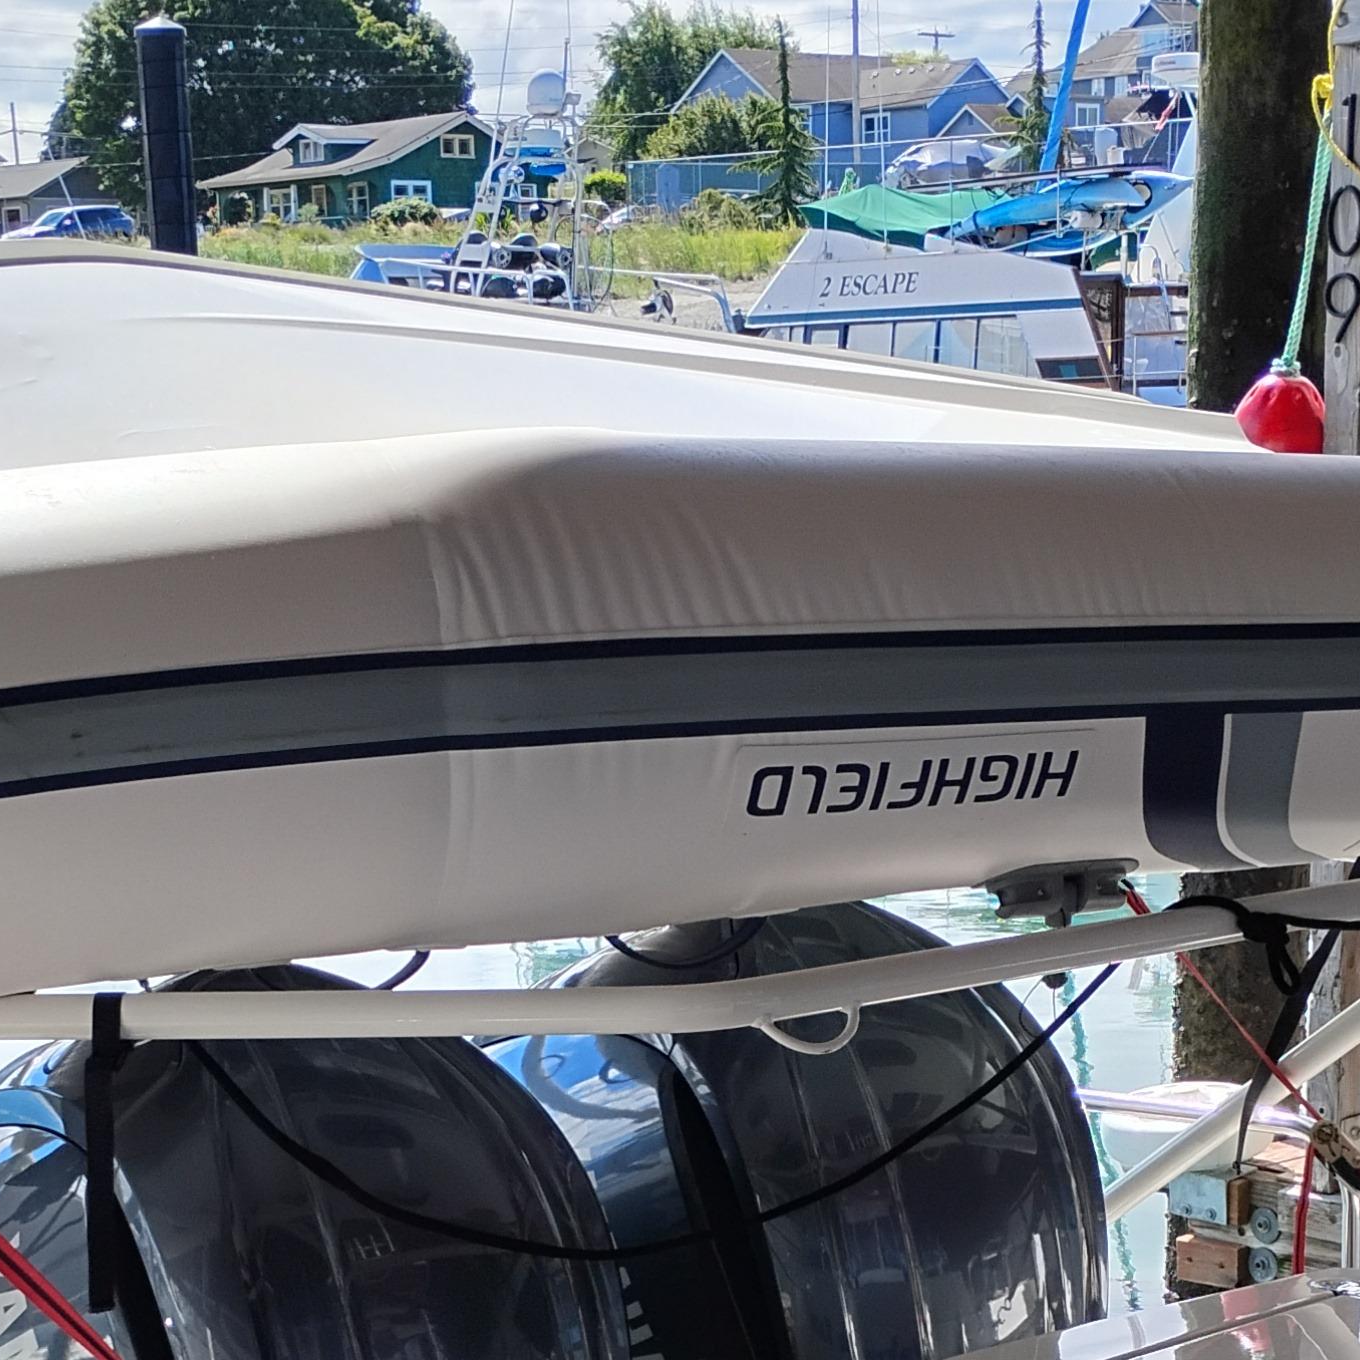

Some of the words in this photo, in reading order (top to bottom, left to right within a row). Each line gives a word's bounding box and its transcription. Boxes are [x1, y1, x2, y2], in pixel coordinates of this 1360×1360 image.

[819, 276, 832, 298] 2
[839, 271, 920, 298] ESCAPE
[746, 750, 1080, 818] HIGHFIELD
